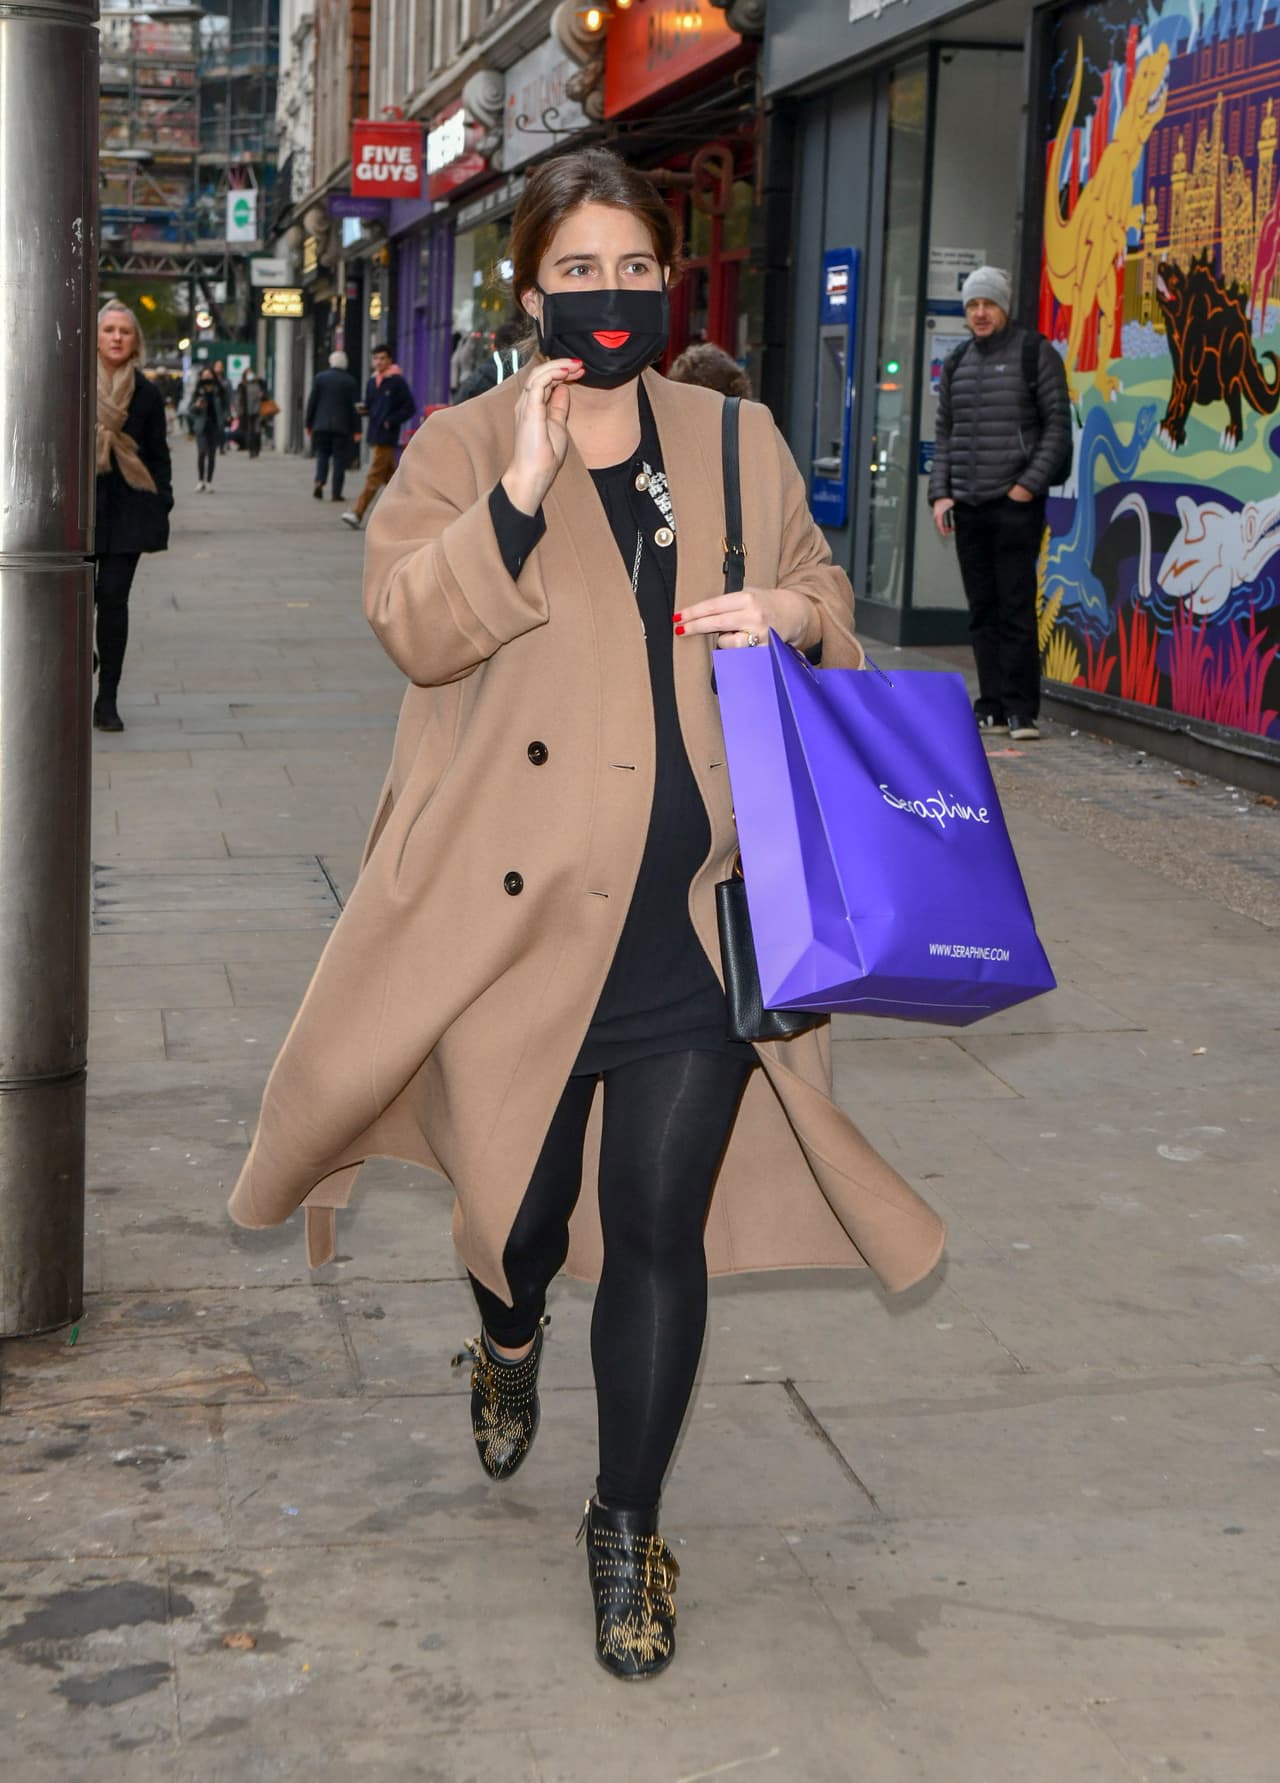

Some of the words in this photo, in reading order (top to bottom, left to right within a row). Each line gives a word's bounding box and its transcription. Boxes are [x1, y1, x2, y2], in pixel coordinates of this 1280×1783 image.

[362, 145, 412, 163] FIVE
[356, 163, 418, 182] GUYS
[879, 784, 990, 828] Seraphine
[929, 943, 1010, 961] WWW.SERAPHINE.COM
